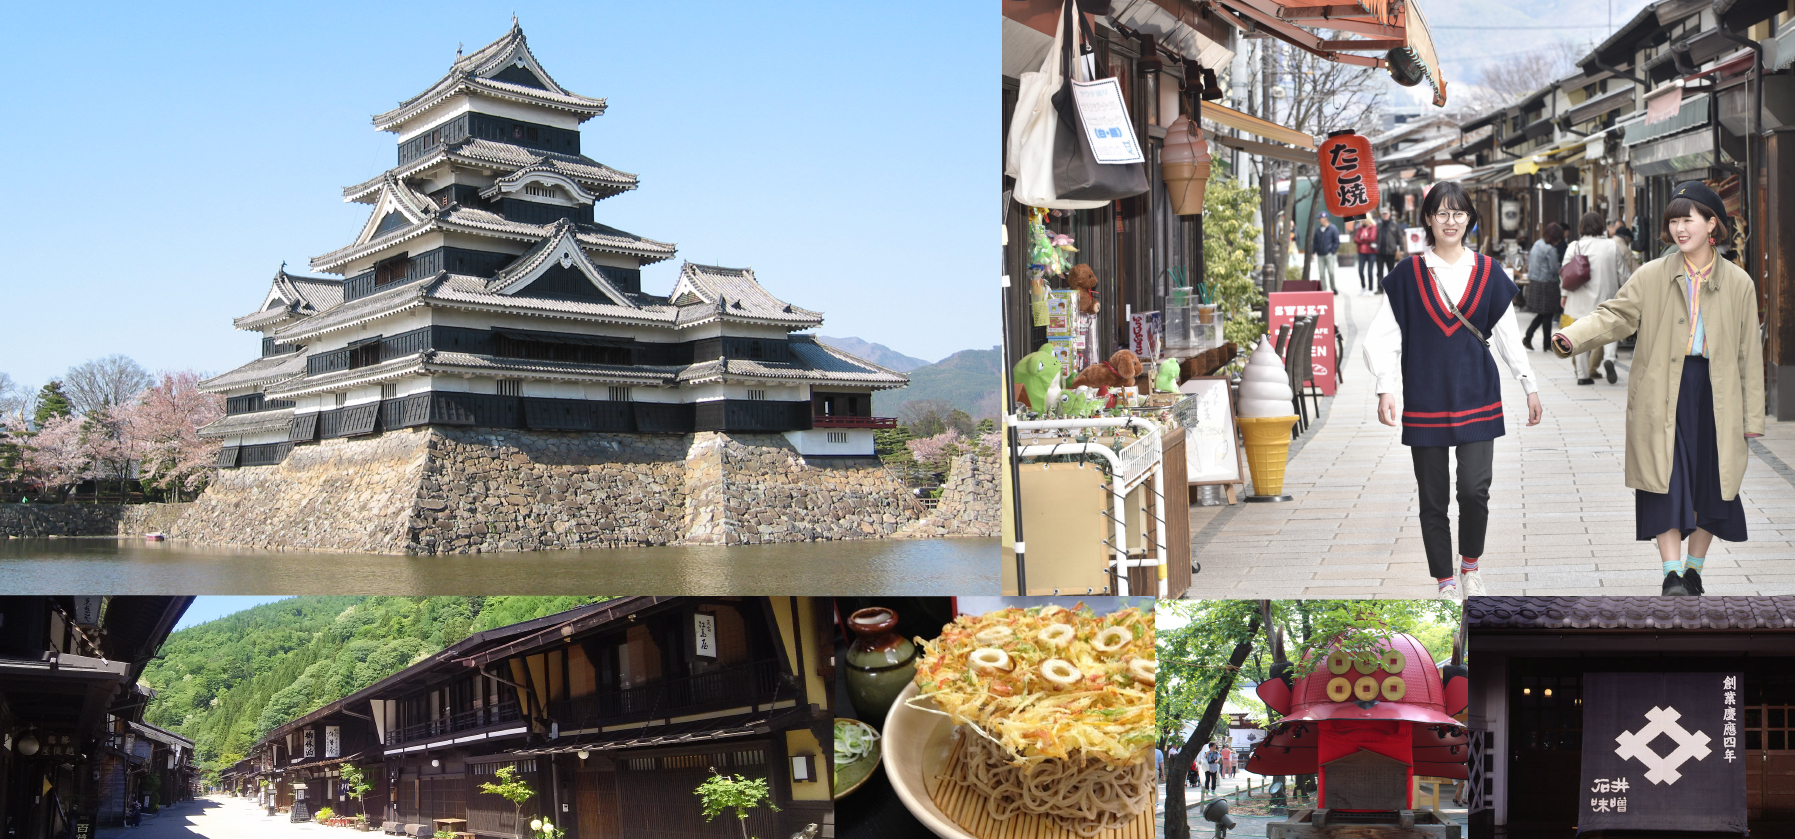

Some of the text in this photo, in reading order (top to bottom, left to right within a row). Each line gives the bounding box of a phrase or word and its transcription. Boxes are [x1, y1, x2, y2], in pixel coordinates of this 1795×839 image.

[1329, 143, 1368, 207] たこ焼
[1274, 305, 1328, 316] SWEET
[1591, 777, 1630, 794] 石井
